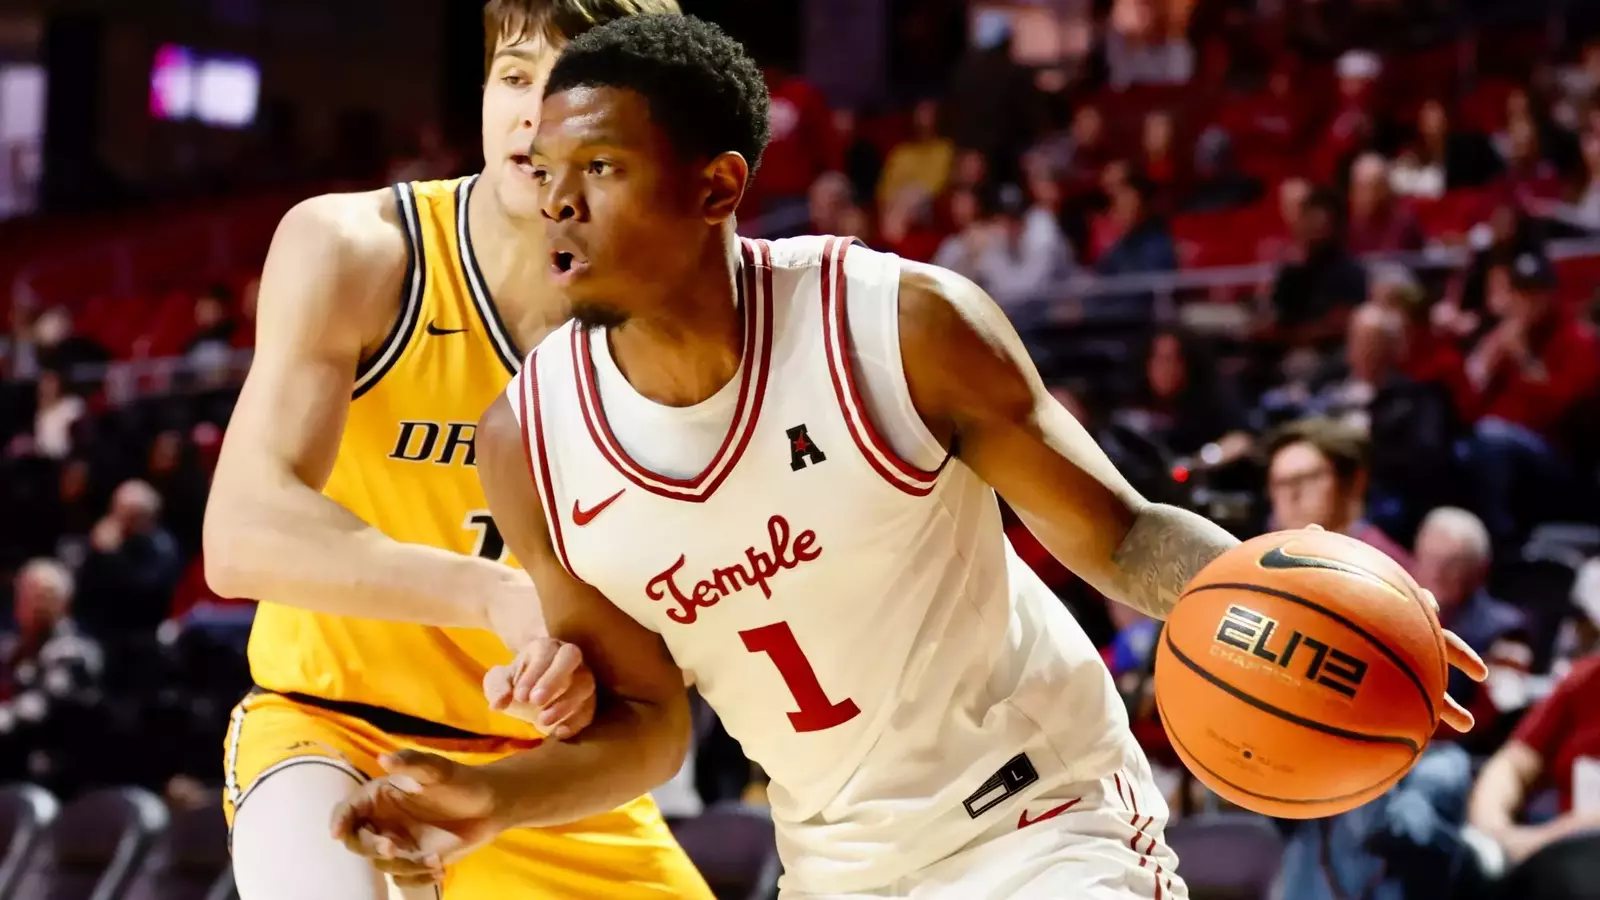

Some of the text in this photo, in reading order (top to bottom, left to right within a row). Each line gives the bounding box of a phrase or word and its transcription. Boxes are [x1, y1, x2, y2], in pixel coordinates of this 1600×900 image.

[645, 514, 823, 625] Temple
[737, 620, 862, 733] 1
[1213, 603, 1369, 699] ELITE
[1011, 770, 1024, 781] L
